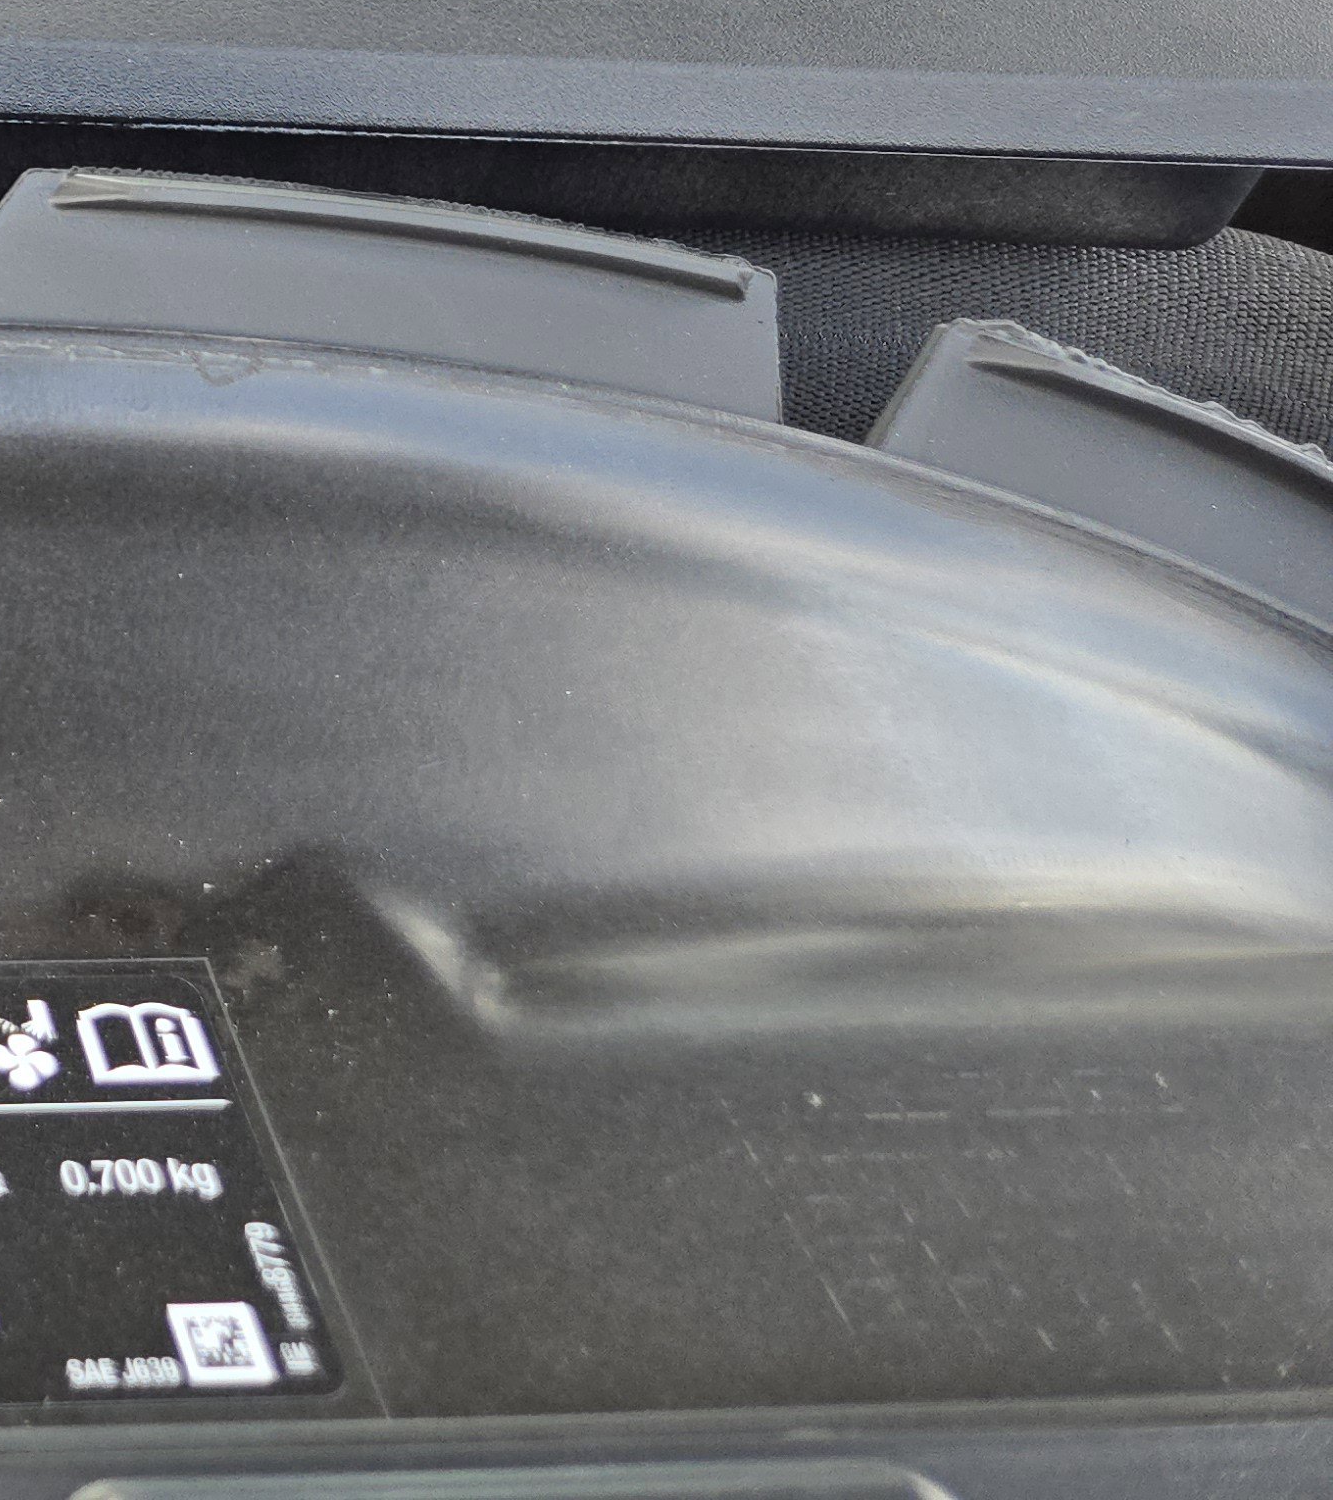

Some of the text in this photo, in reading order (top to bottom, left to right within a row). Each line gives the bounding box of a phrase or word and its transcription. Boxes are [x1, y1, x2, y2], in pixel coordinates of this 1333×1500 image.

[59, 1157, 166, 1196] 0.700
[166, 1157, 224, 1201] kg
[66, 1356, 182, 1389] SAE J639
